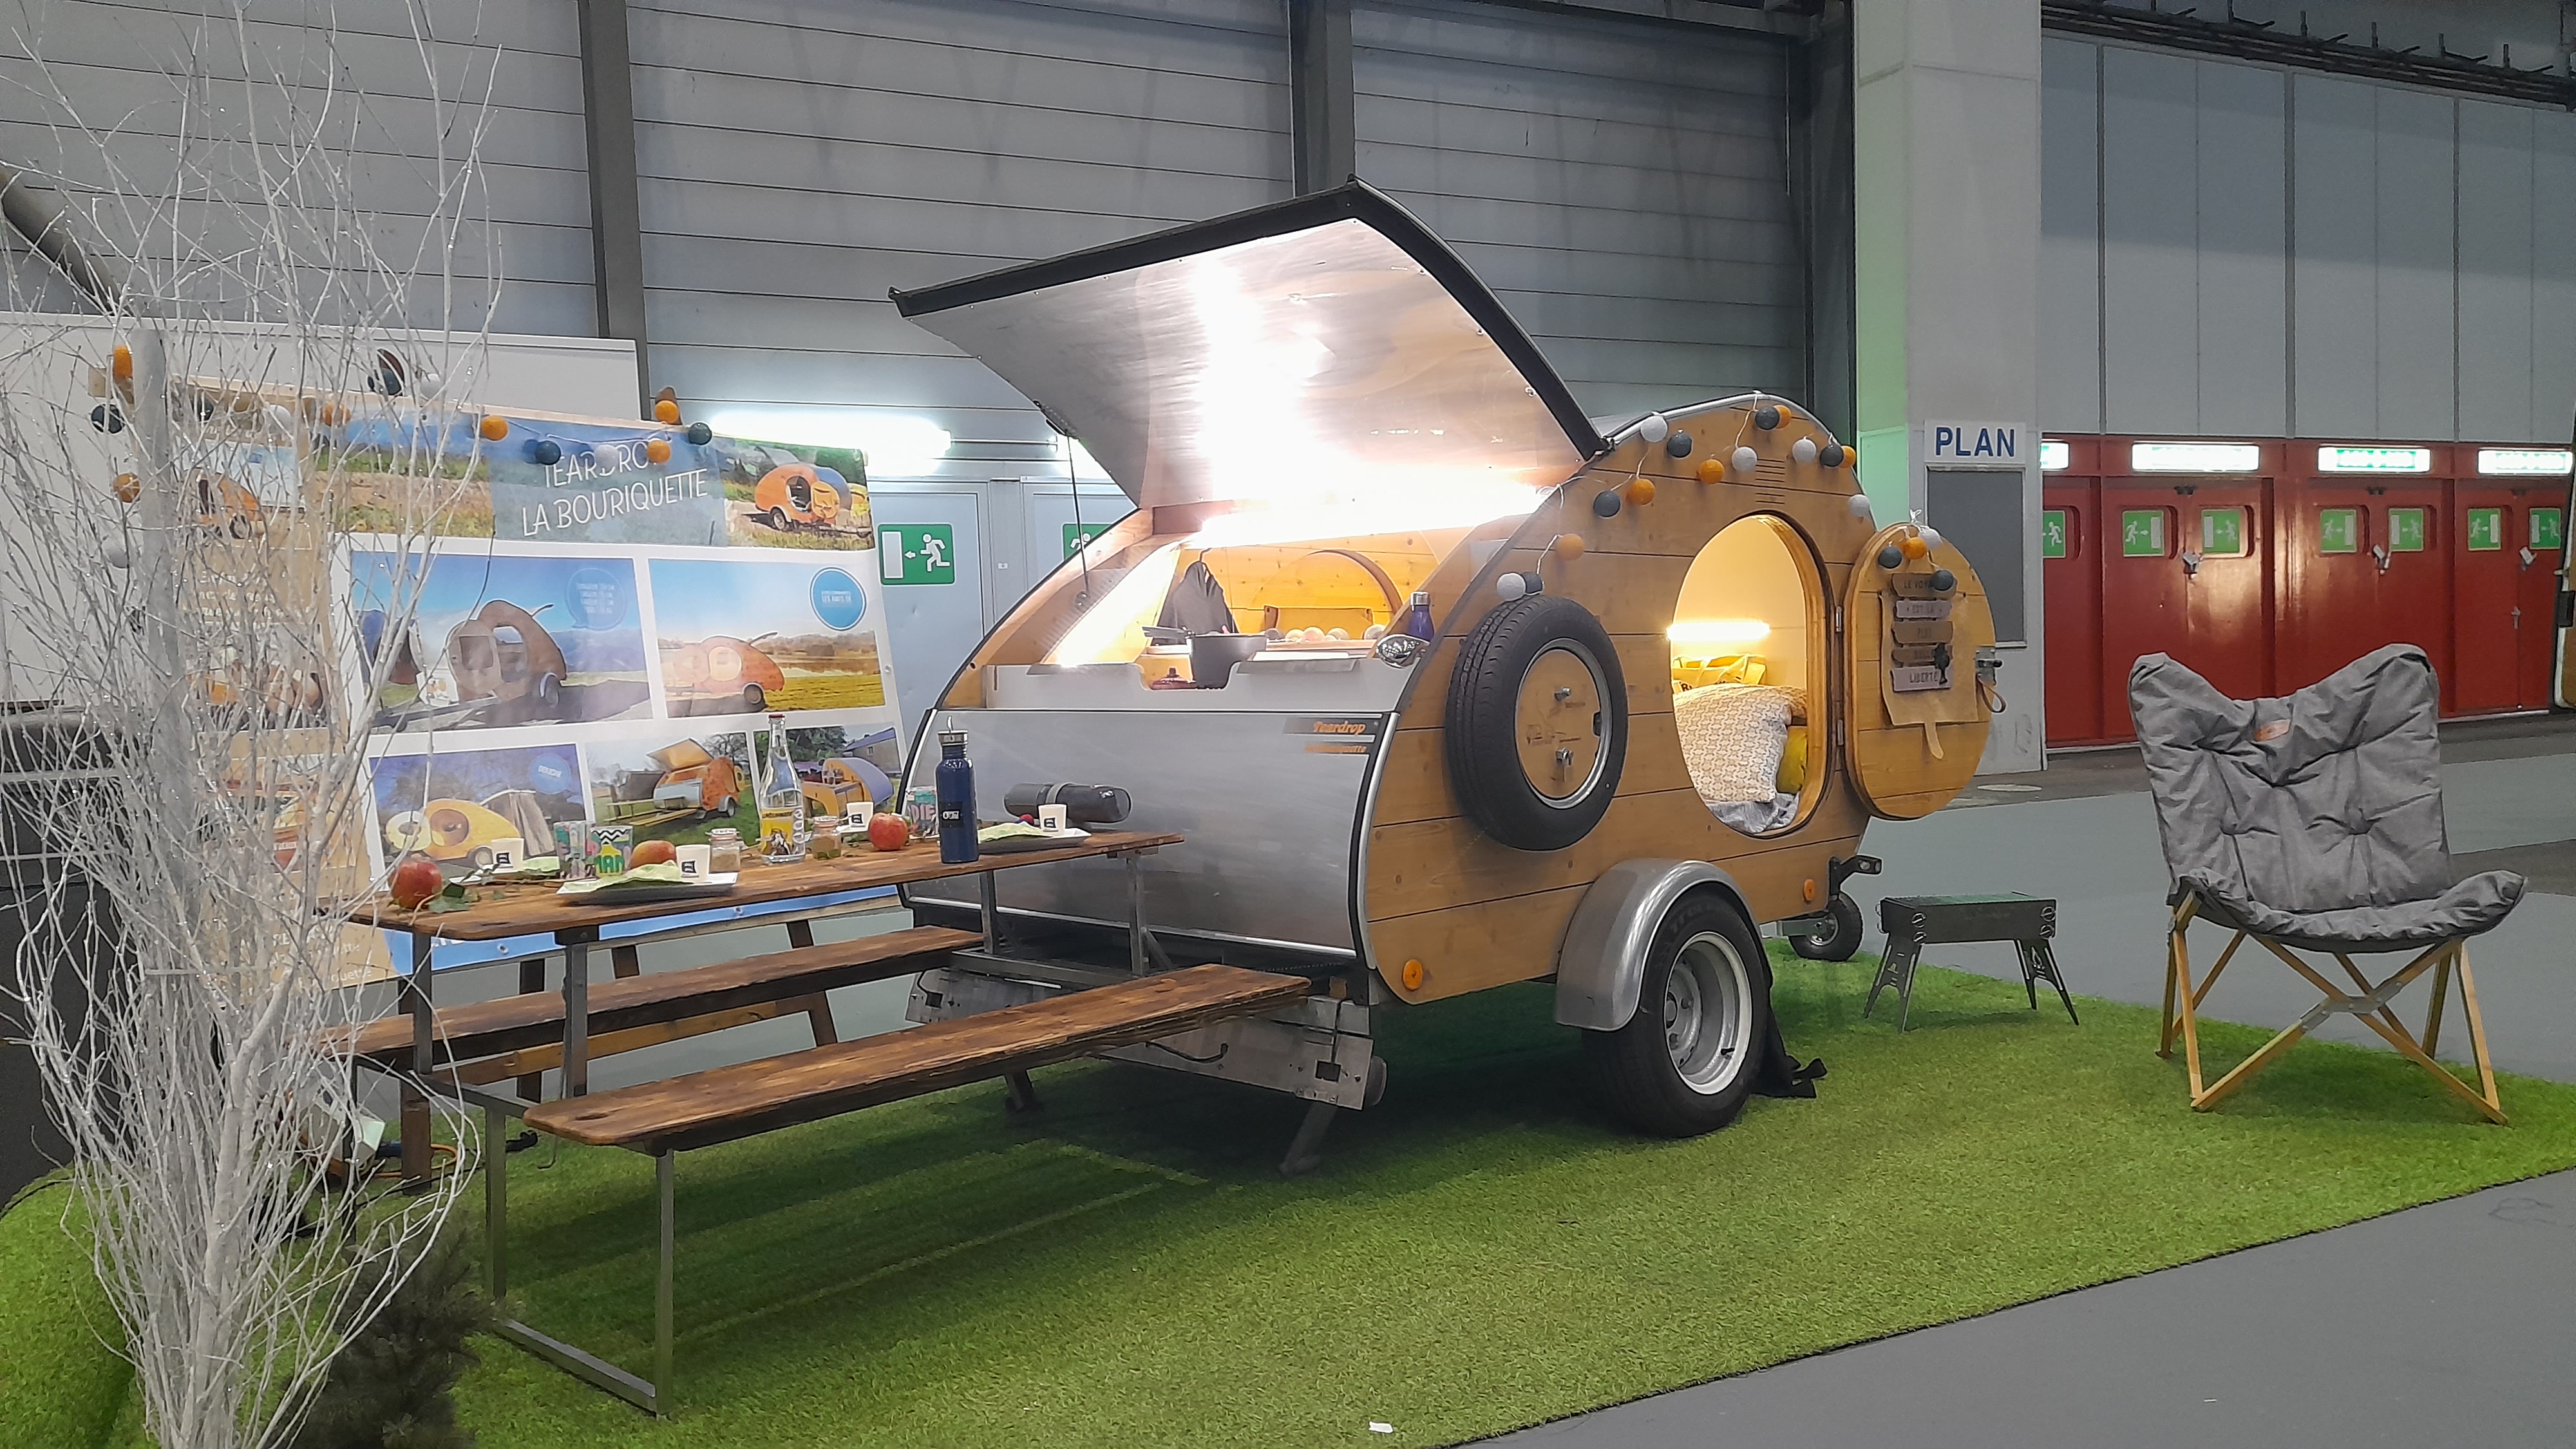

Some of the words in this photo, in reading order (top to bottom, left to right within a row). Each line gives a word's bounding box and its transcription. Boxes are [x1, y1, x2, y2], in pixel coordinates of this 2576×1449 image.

[1935, 426, 2014, 457] PLAN
[544, 441, 658, 488] TEARRO
[522, 503, 551, 536] LA
[553, 468, 708, 529] BOURIQUETTE
[1313, 720, 1367, 735] Teardrop
